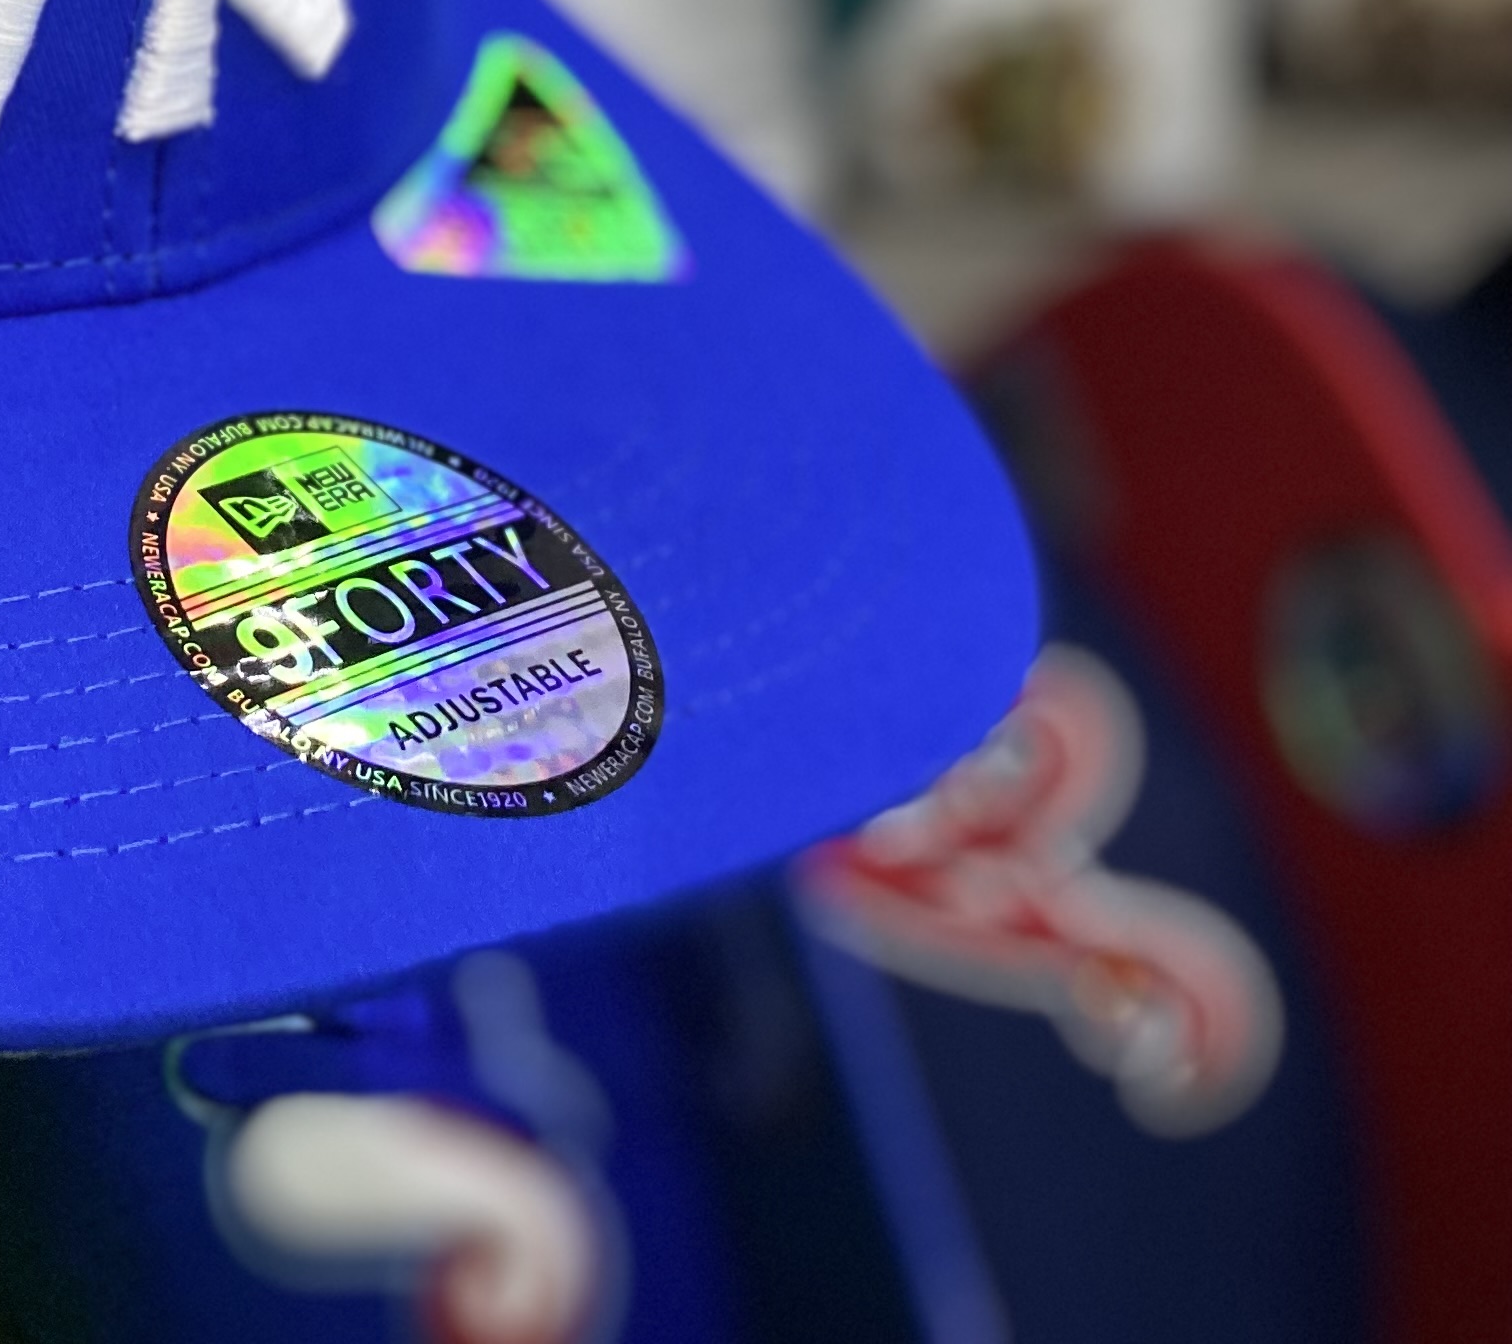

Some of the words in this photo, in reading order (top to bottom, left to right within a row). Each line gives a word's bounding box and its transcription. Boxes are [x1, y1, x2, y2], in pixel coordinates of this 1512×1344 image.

[190, 422, 253, 456] BUFALO
[150, 473, 178, 503] USA
[294, 462, 356, 494] NEW
[312, 480, 376, 512] ERA
[572, 543, 605, 576] USA
[141, 531, 229, 686] NEWERACAP.COM
[235, 527, 551, 685] 9FORTY
[620, 616, 654, 680] BUFALO
[388, 649, 603, 751] ADJUSTABLE
